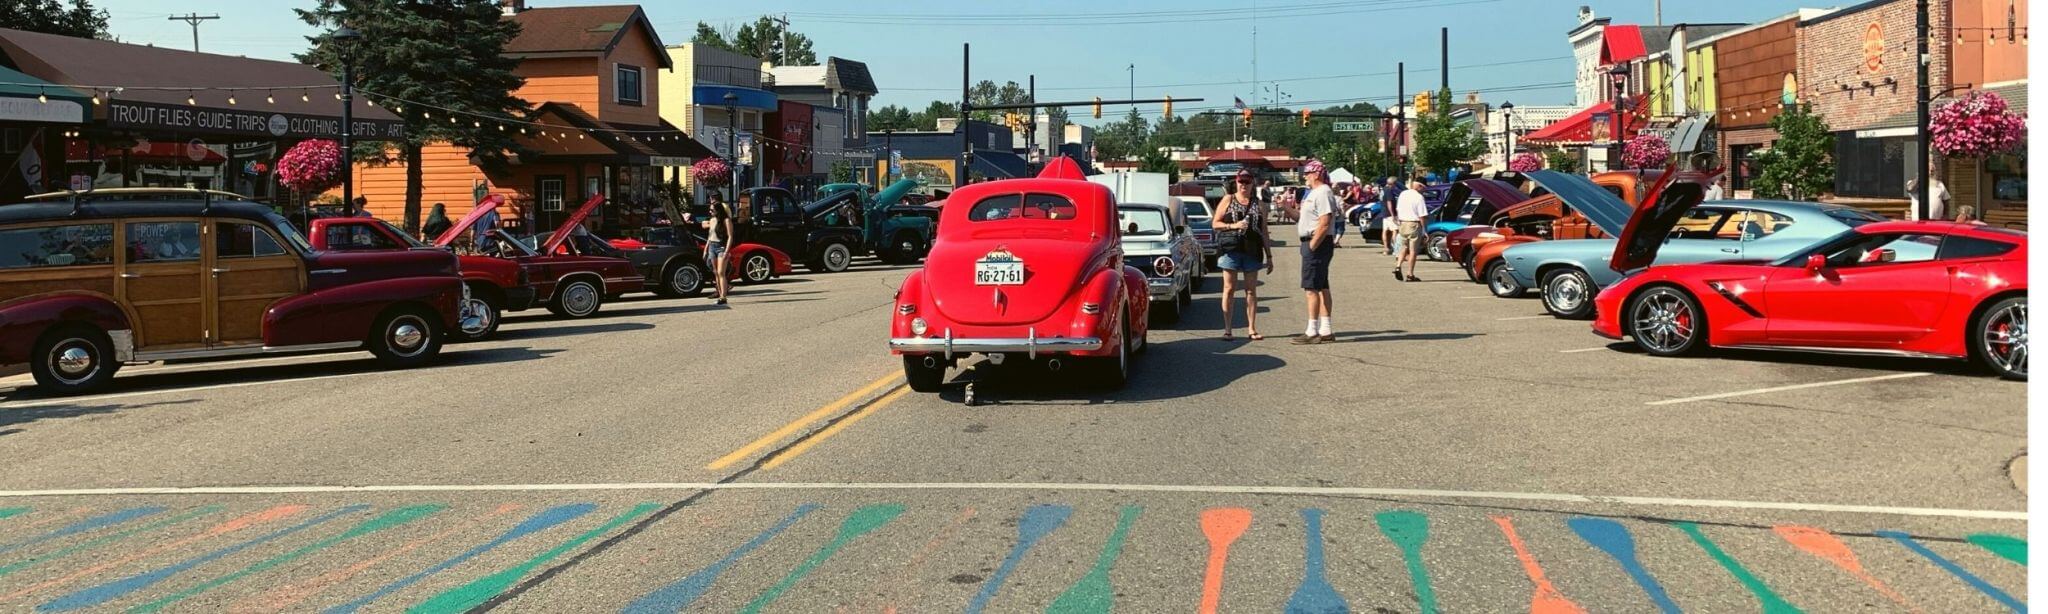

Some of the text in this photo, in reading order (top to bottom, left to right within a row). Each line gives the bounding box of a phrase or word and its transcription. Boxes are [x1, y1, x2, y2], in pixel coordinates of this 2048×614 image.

[112, 104, 156, 123] TROUT
[158, 108, 191, 127] FLIES
[197, 111, 233, 129] GUIDE
[235, 114, 266, 132] TRIPS
[290, 118, 338, 135] CLOTHING
[351, 121, 377, 136] GIFTS
[387, 123, 404, 137] ART
